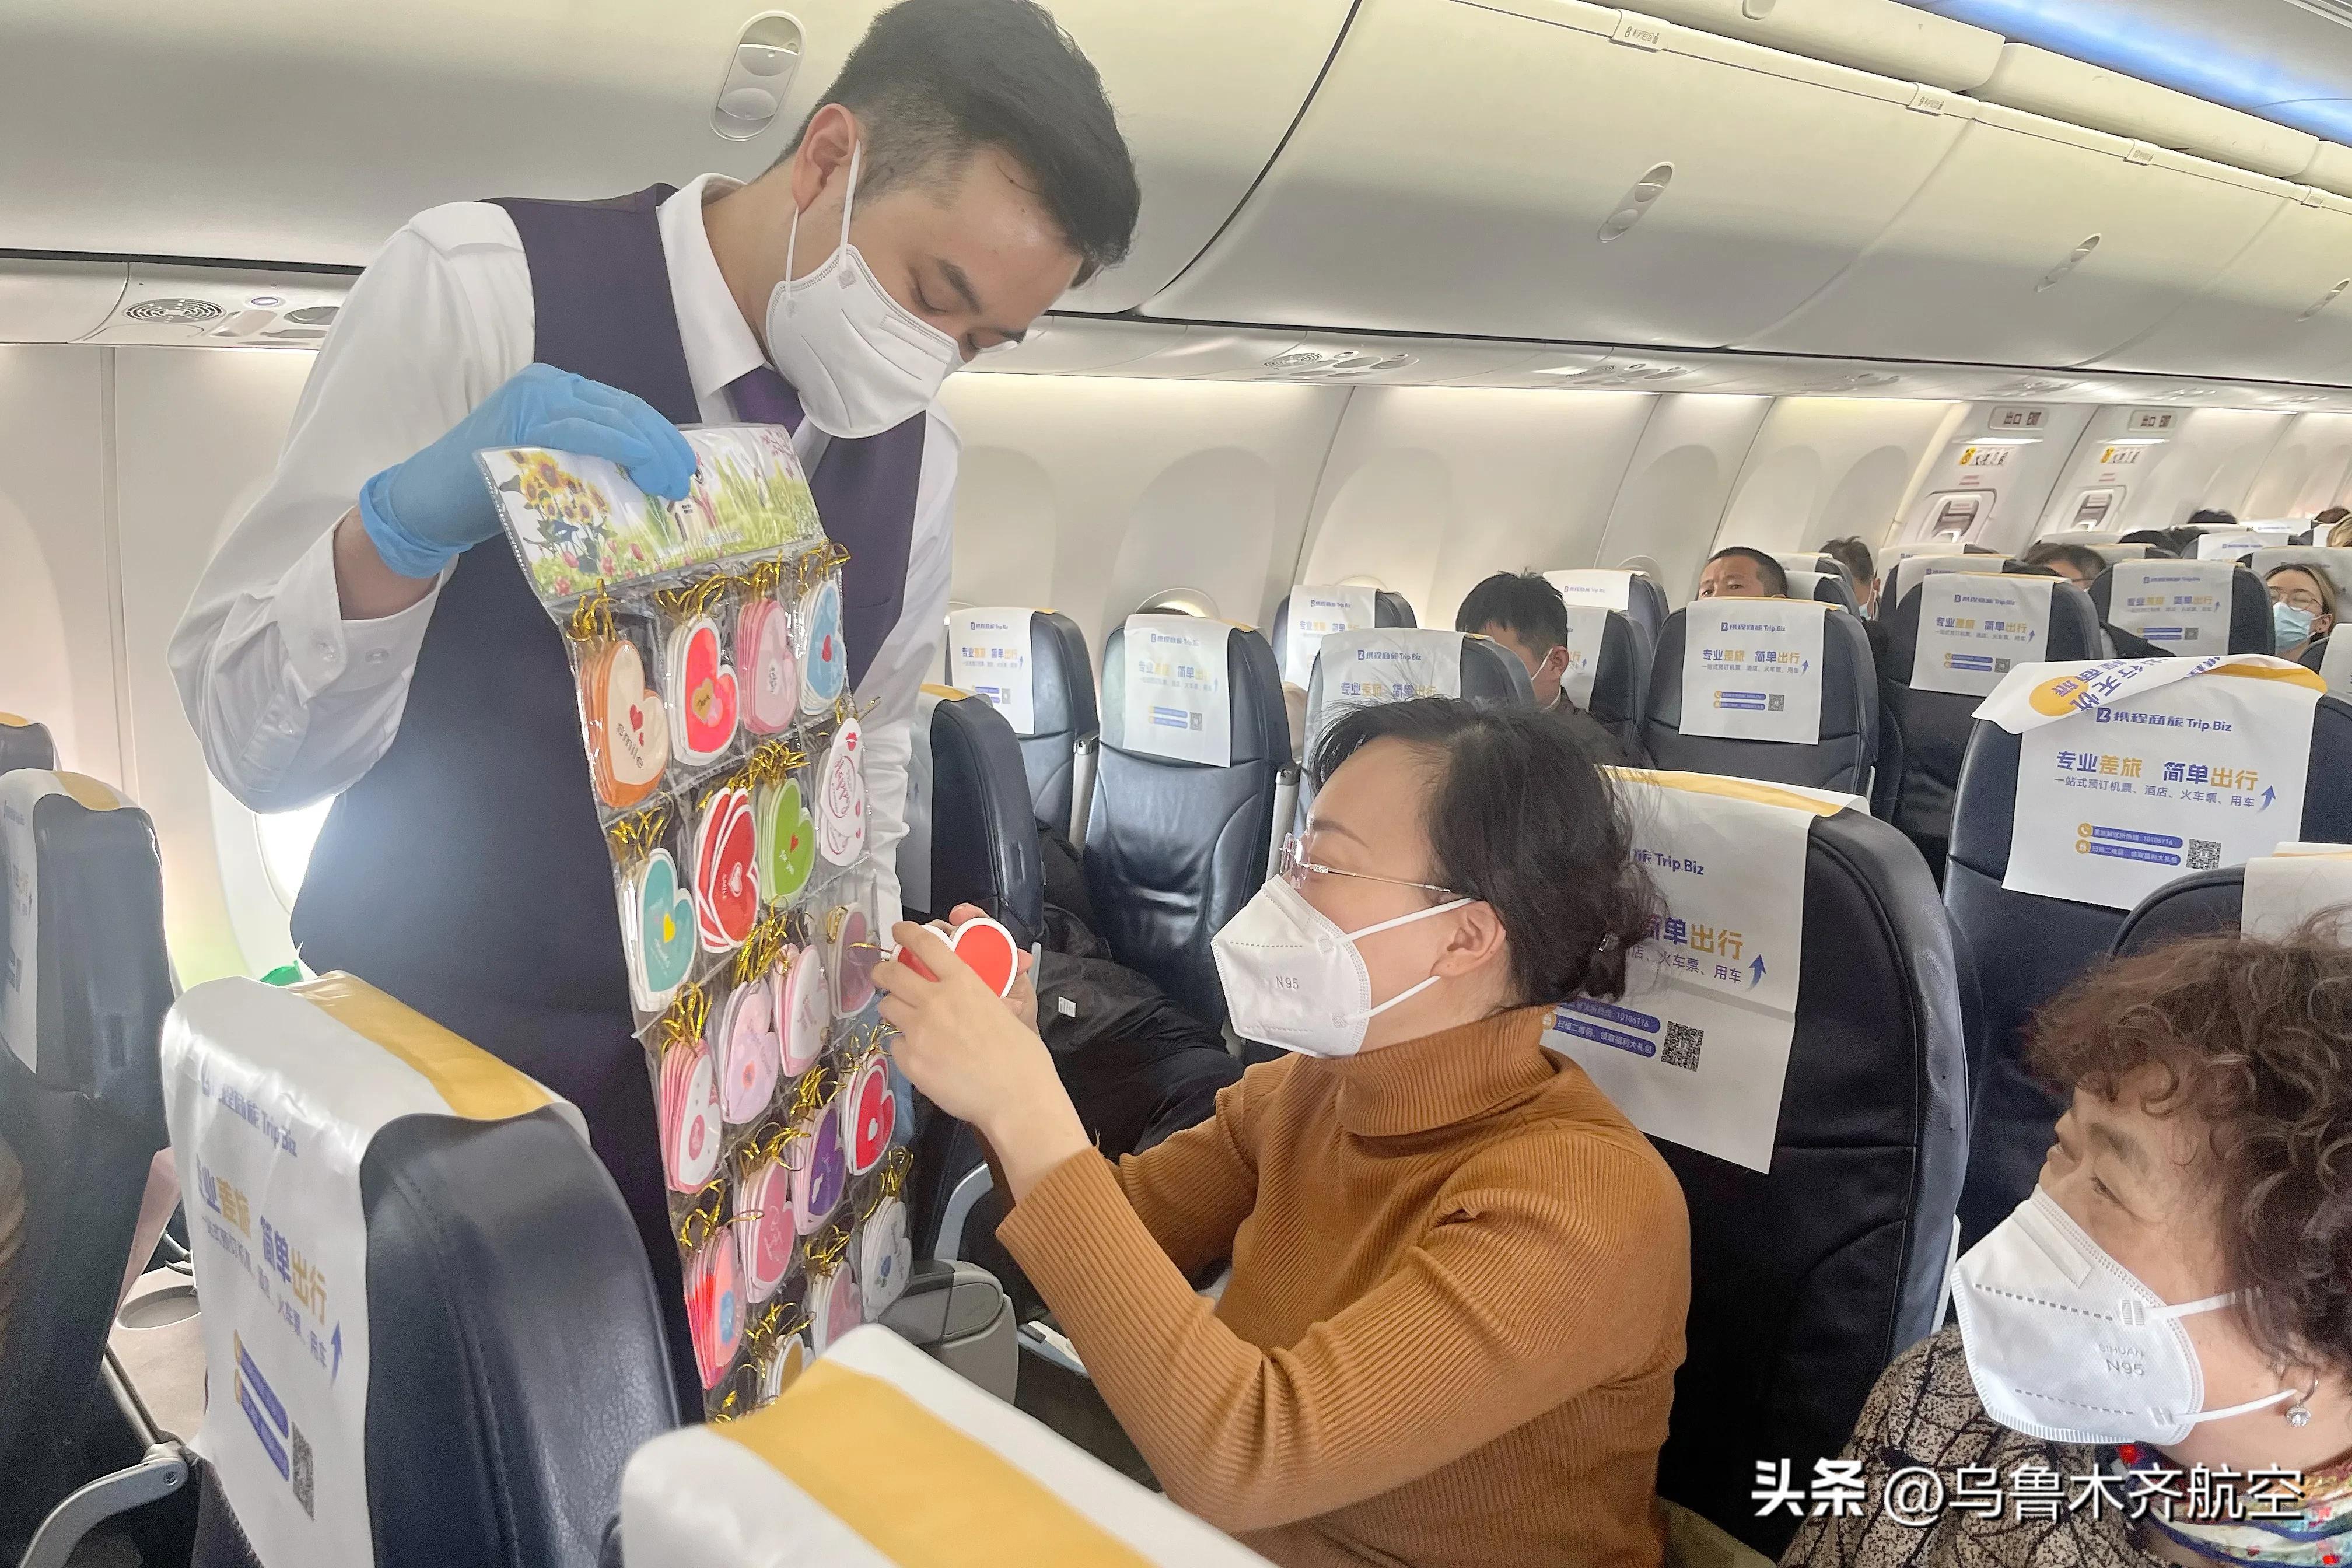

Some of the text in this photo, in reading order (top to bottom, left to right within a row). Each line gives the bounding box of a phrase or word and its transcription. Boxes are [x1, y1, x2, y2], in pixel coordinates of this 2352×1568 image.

[1755, 650, 1800, 664] 简单出行
[2056, 750, 2259, 791] 专业差旅 简单出行
[1654, 852, 1704, 875] Trip.Biz
[1275, 976, 1299, 990] N95
[2106, 1359, 2144, 1376] N95
